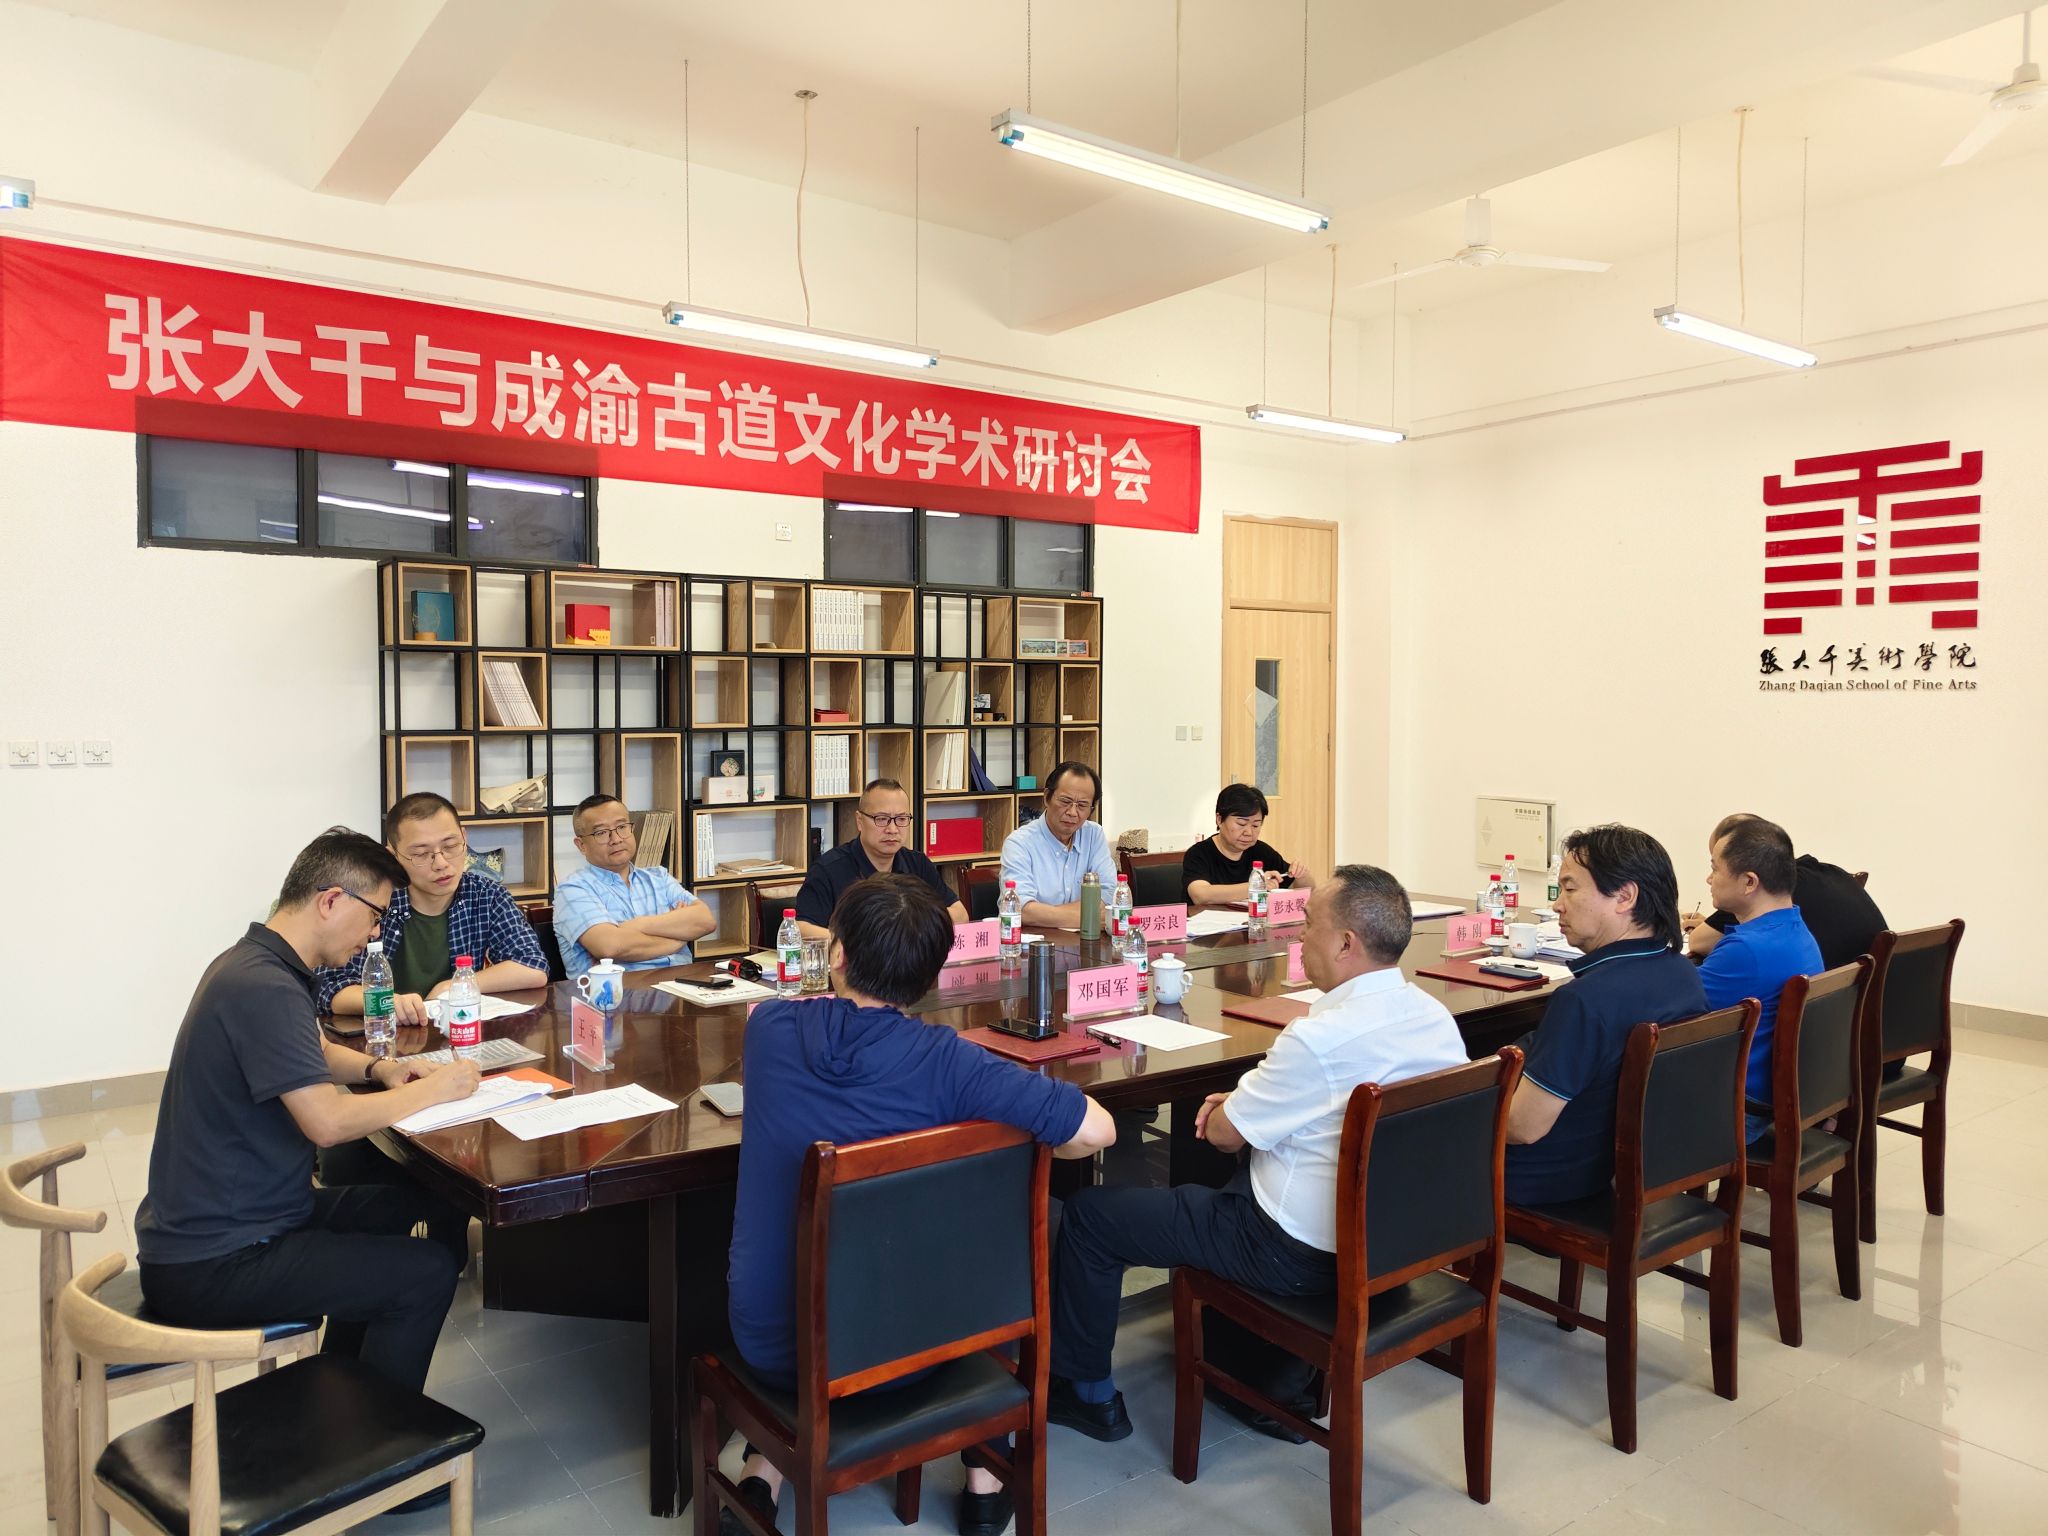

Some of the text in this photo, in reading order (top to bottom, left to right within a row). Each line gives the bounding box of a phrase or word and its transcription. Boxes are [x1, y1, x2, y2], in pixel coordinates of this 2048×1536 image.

[1759, 678, 1977, 692] Zhang Daqian School of Fine Arts
[1140, 914, 1179, 931] 罗宗良
[1077, 977, 1129, 1001] 邓国军
